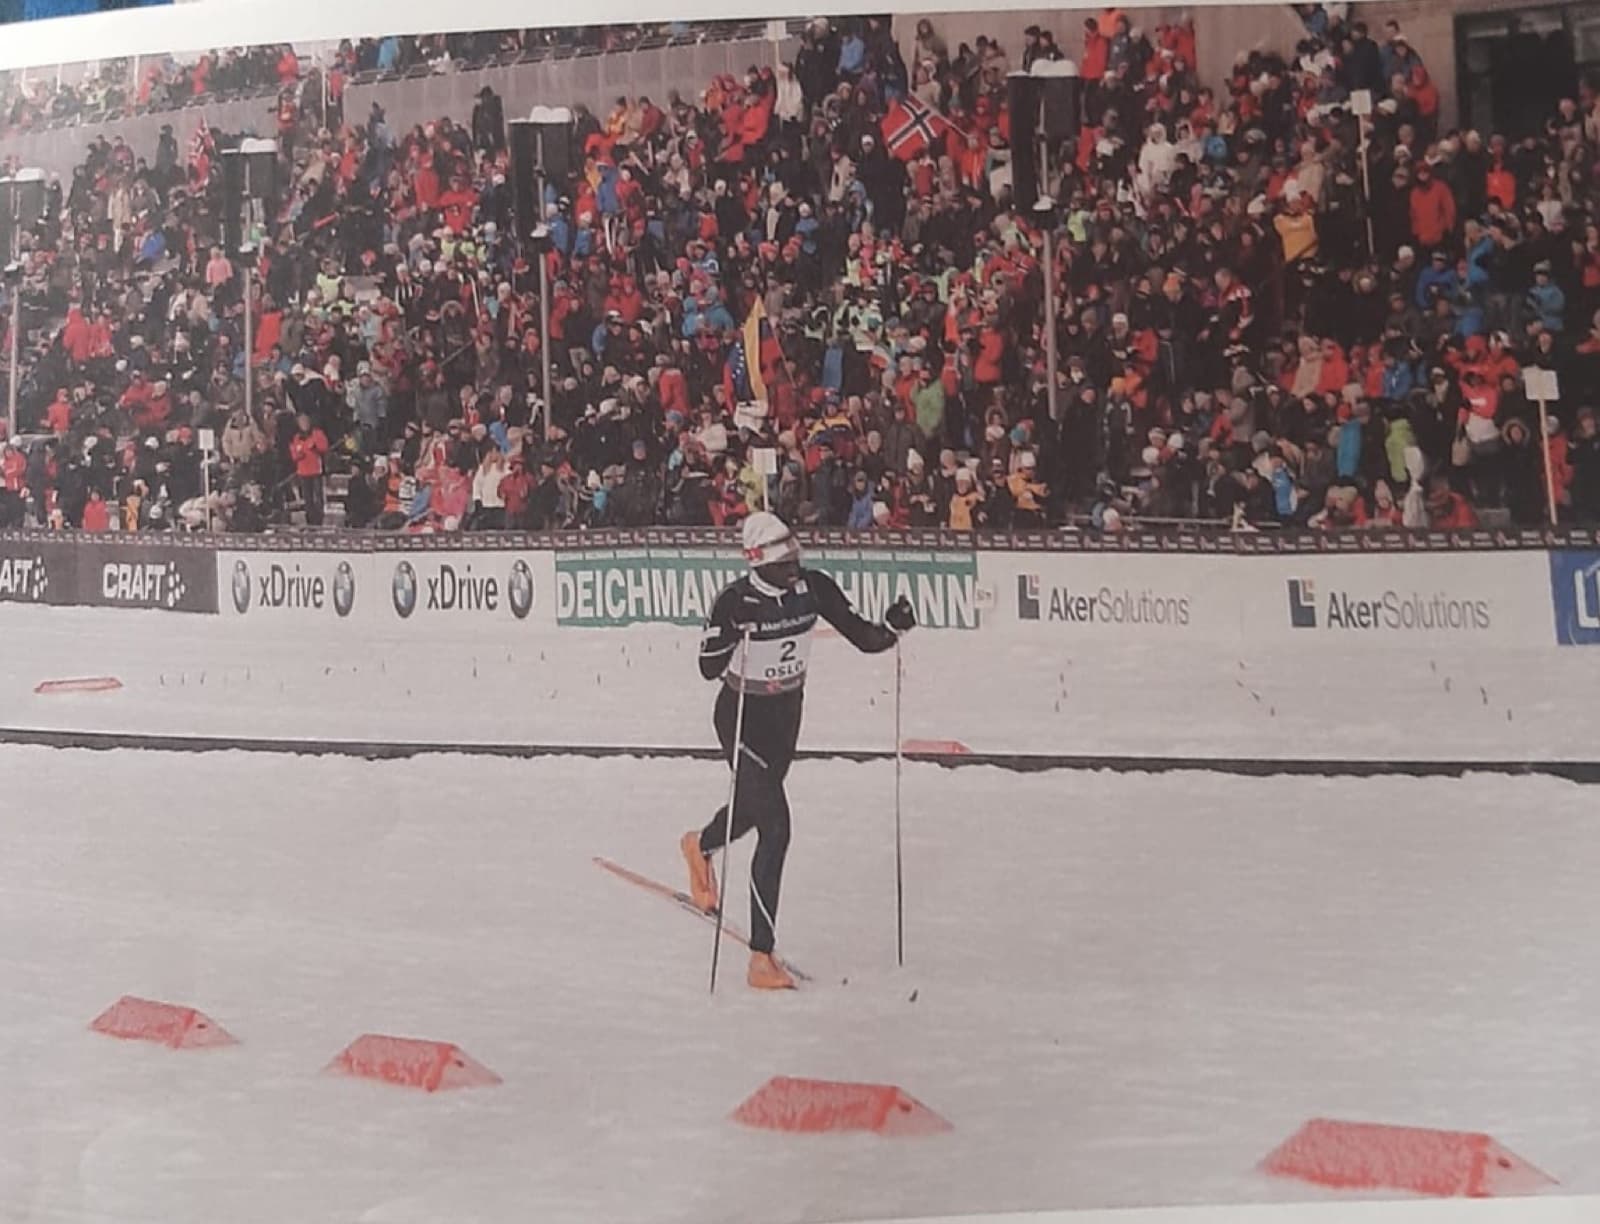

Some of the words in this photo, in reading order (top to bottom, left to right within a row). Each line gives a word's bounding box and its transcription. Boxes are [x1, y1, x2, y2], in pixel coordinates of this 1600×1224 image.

[103, 563, 167, 600] CRAFT
[259, 564, 325, 608] xDrive
[427, 564, 498, 611] xDrive
[556, 568, 748, 618] DEICHMAN
[1049, 586, 1190, 626] AkerSolutions
[1327, 590, 1490, 630] AkerSolutions
[780, 640, 797, 662] 2
